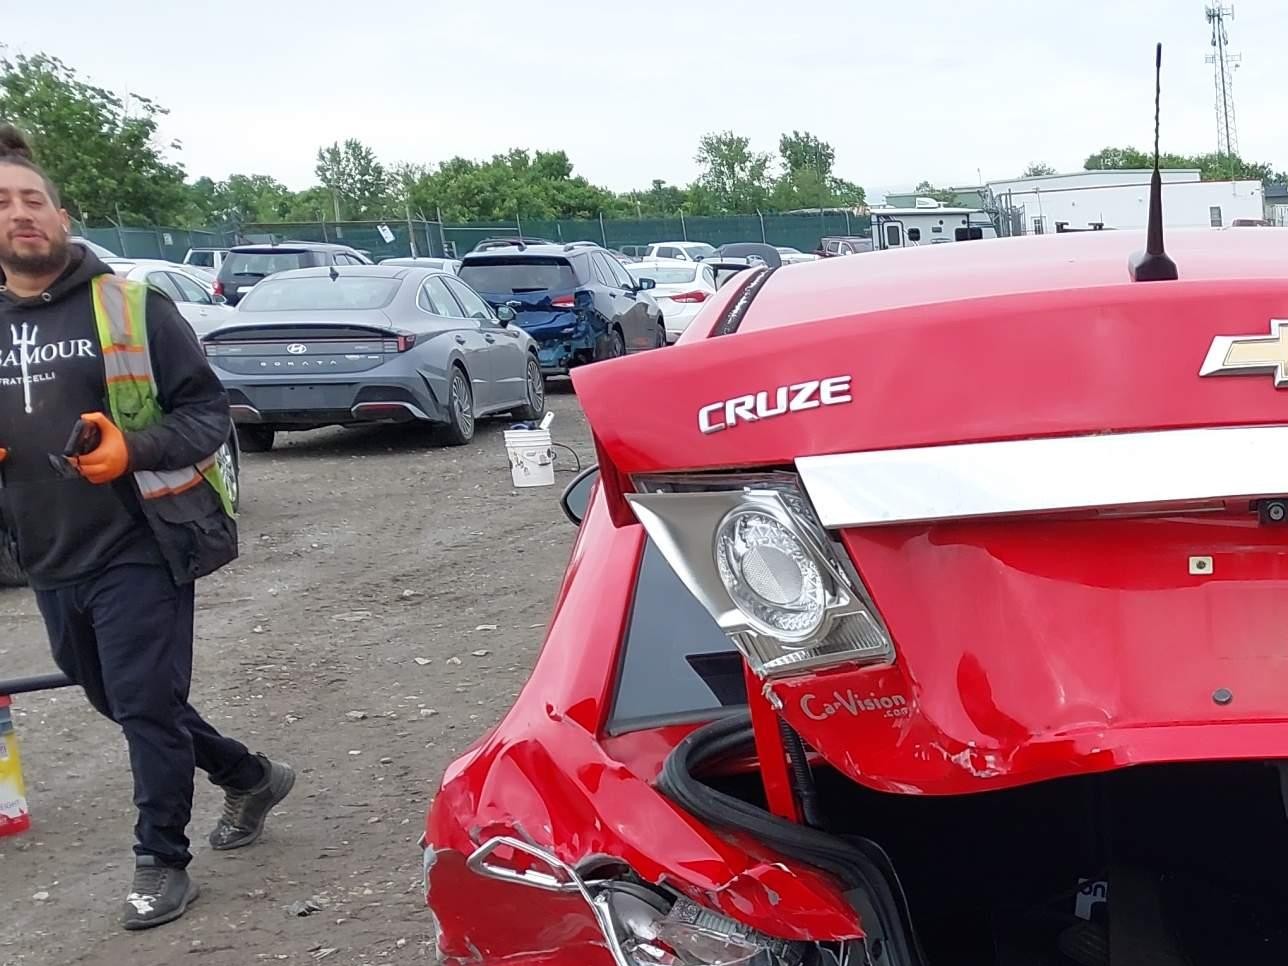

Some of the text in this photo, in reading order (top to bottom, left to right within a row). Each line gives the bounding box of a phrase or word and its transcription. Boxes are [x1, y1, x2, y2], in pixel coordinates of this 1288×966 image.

[0, 339, 96, 367] AMOUR
[699, 375, 852, 434] CRUZE
[800, 689, 906, 720] CarVision
